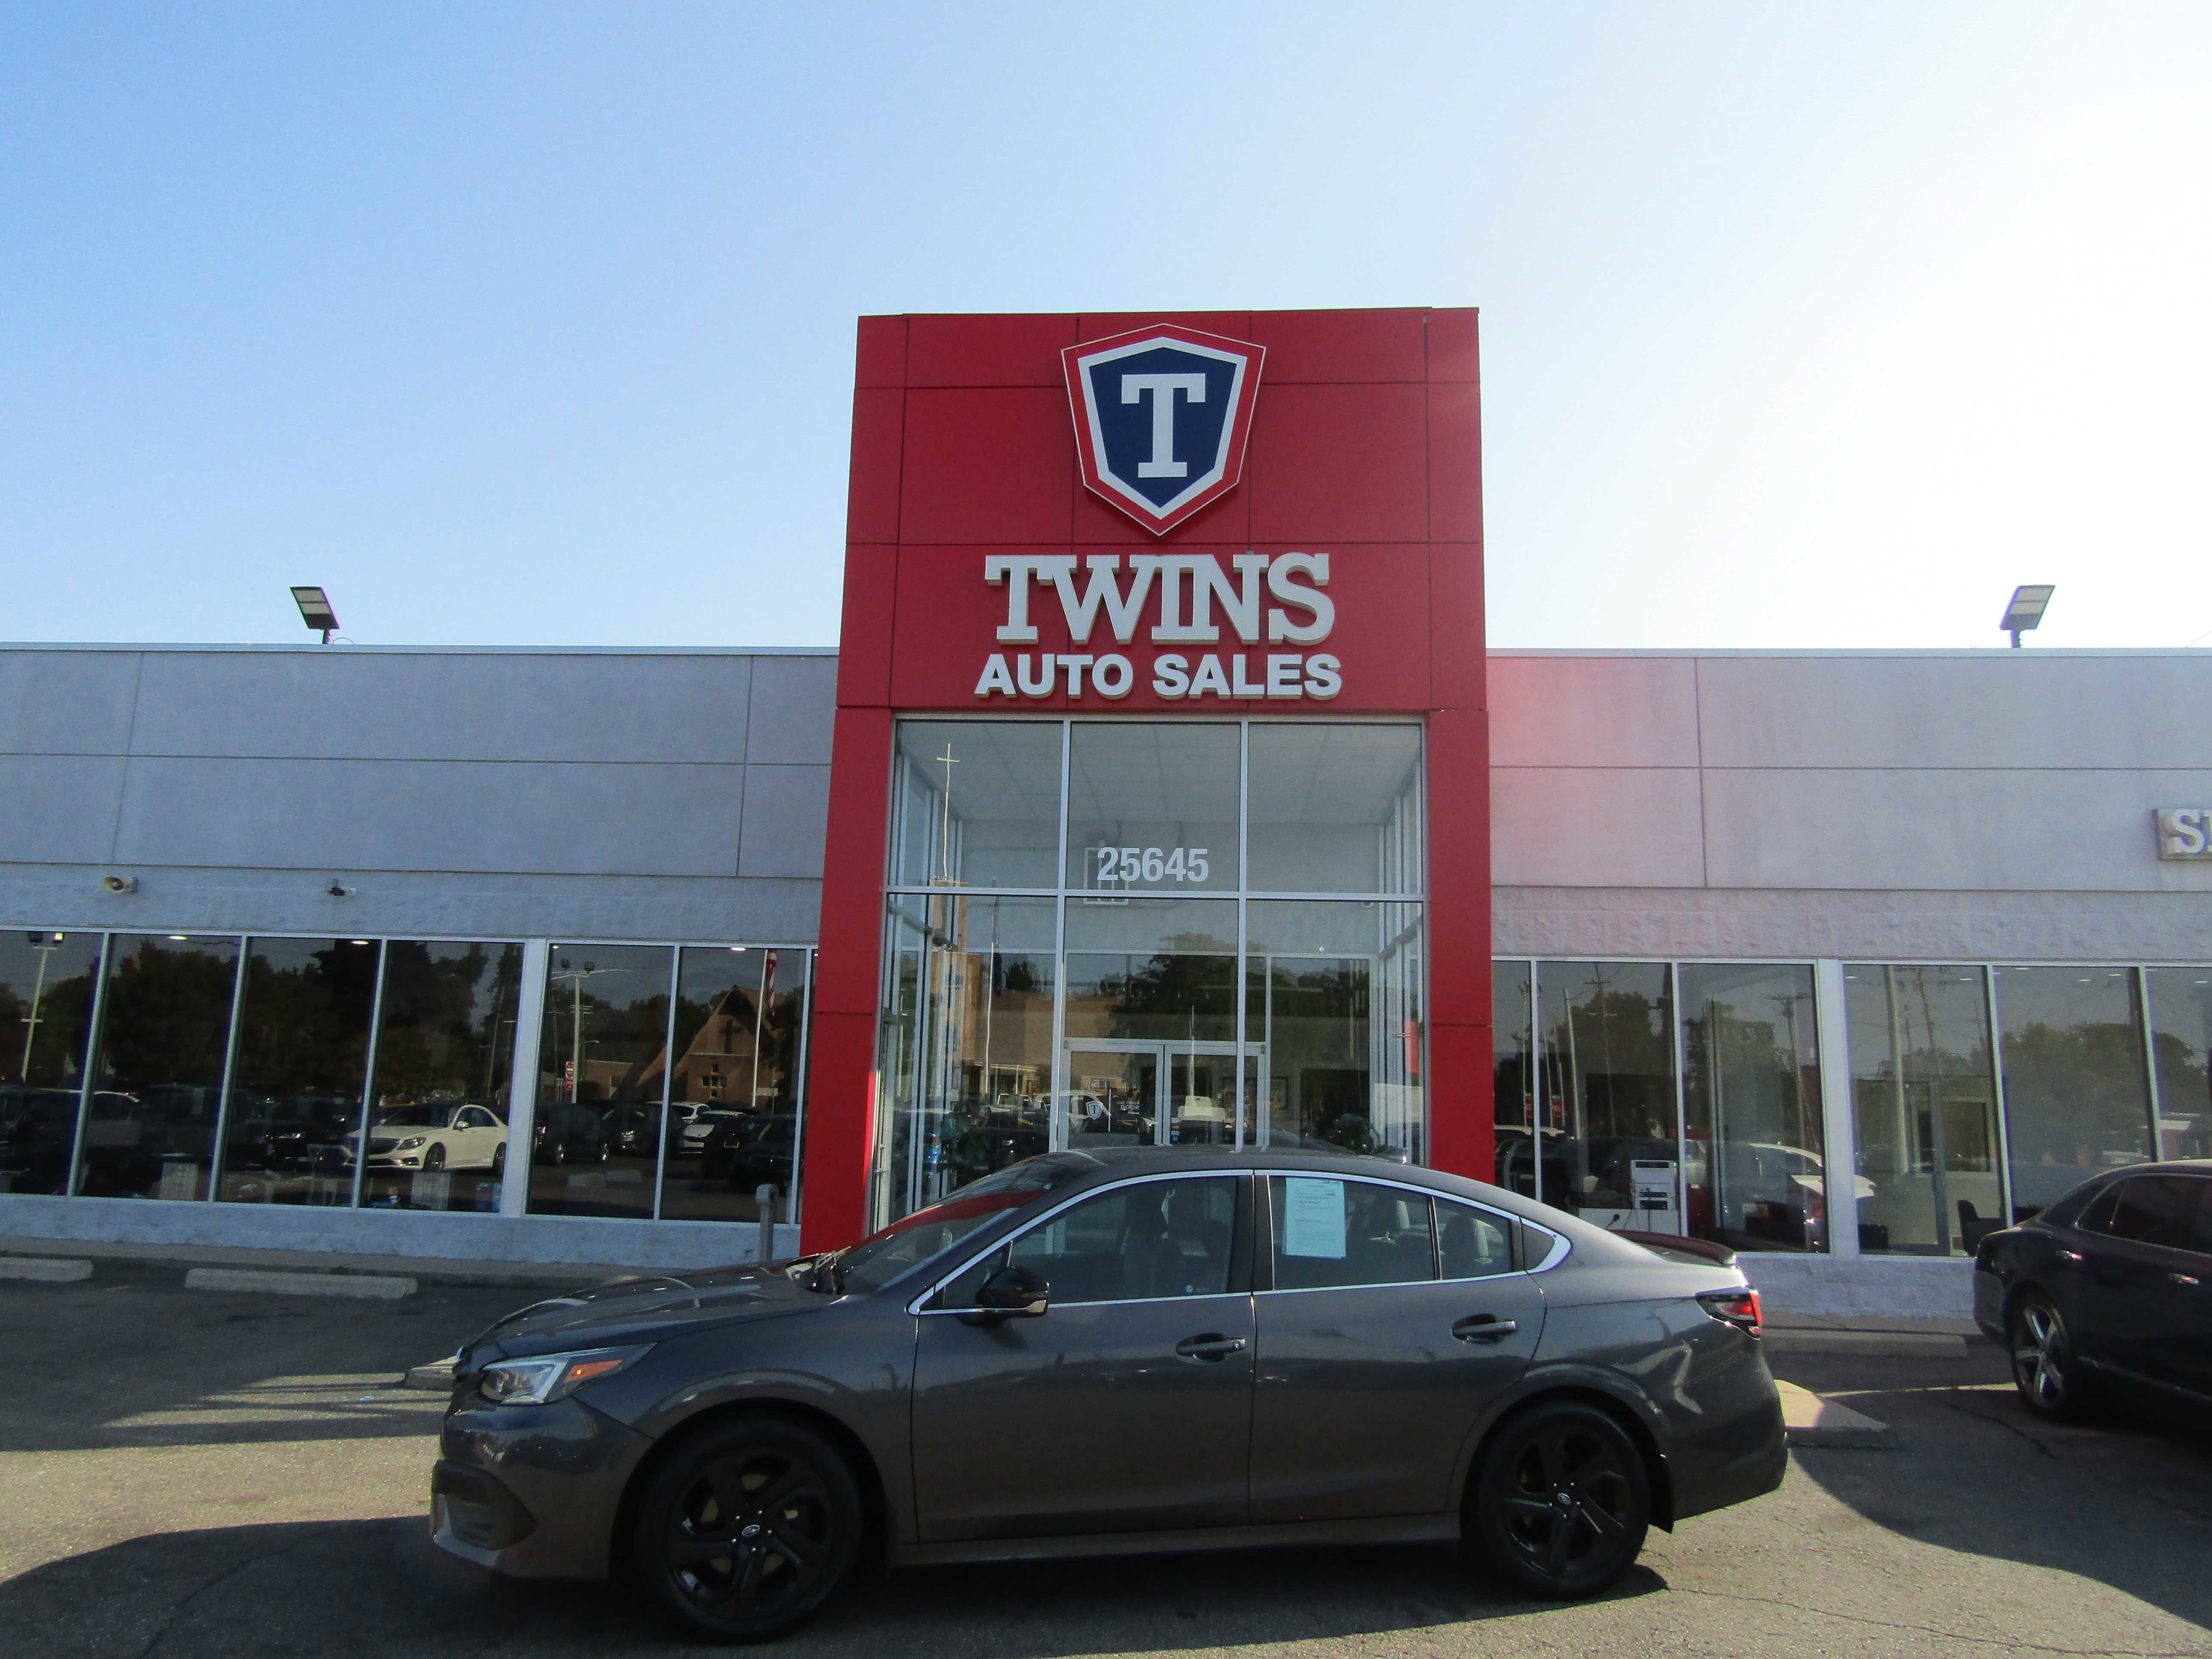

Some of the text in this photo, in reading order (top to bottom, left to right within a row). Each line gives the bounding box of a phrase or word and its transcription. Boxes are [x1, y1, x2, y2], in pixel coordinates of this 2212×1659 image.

[1121, 374, 1205, 477] T
[985, 552, 1335, 645] TWINS
[974, 653, 1342, 700] AUTO SALES
[2168, 809, 2212, 854] S
[1097, 847, 1209, 881] 25645
